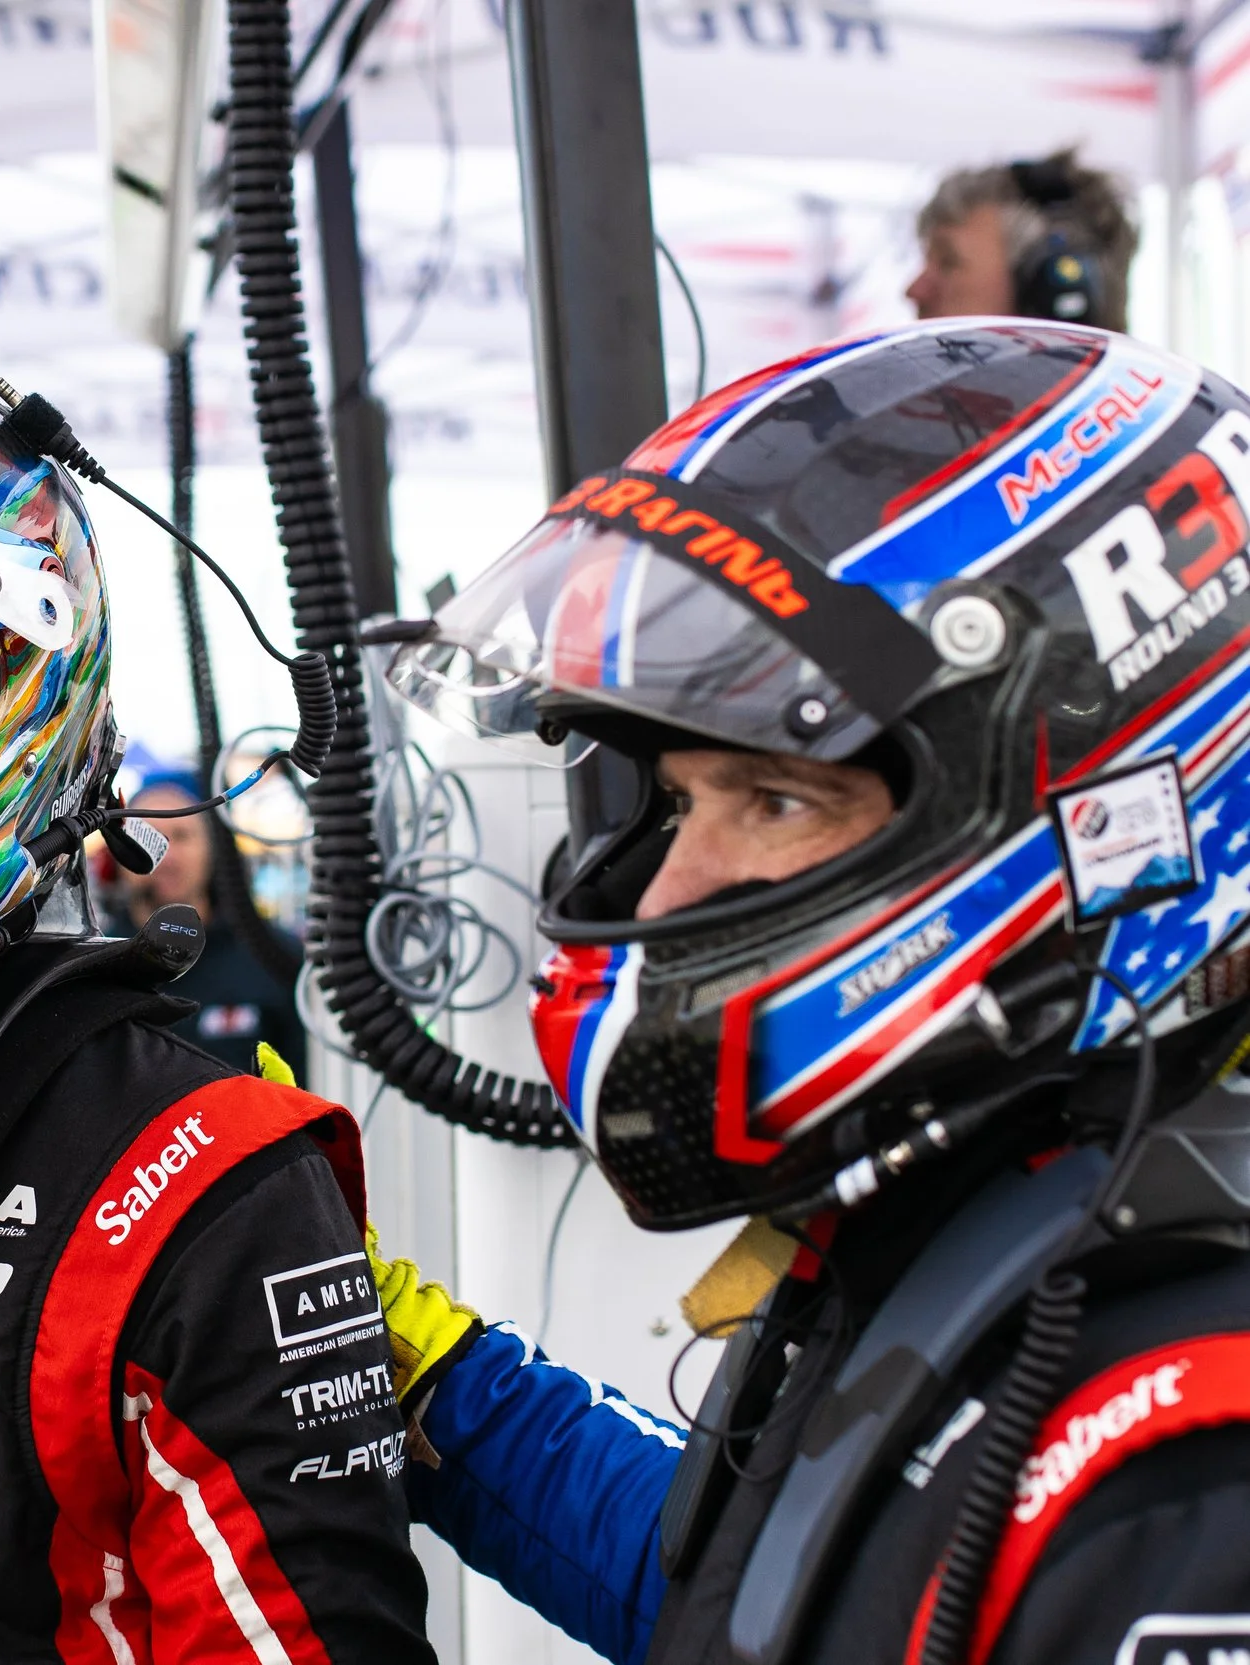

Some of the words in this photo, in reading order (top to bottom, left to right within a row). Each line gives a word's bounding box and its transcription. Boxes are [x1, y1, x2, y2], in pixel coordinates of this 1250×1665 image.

[997, 367, 1164, 524] McCALL
[584, 478, 810, 619] RACING
[1108, 577, 1228, 692] ROUND
[159, 922, 198, 937] ZERO
[94, 1115, 215, 1246] Sabelt
[279, 1338, 337, 1363] AMERICAN
[337, 1326, 376, 1348] EQUIPMENT
[281, 1363, 393, 1417] TRIM-TE
[297, 1408, 360, 1431] DRYWALL
[1012, 1365, 1185, 1525] Sabelt
